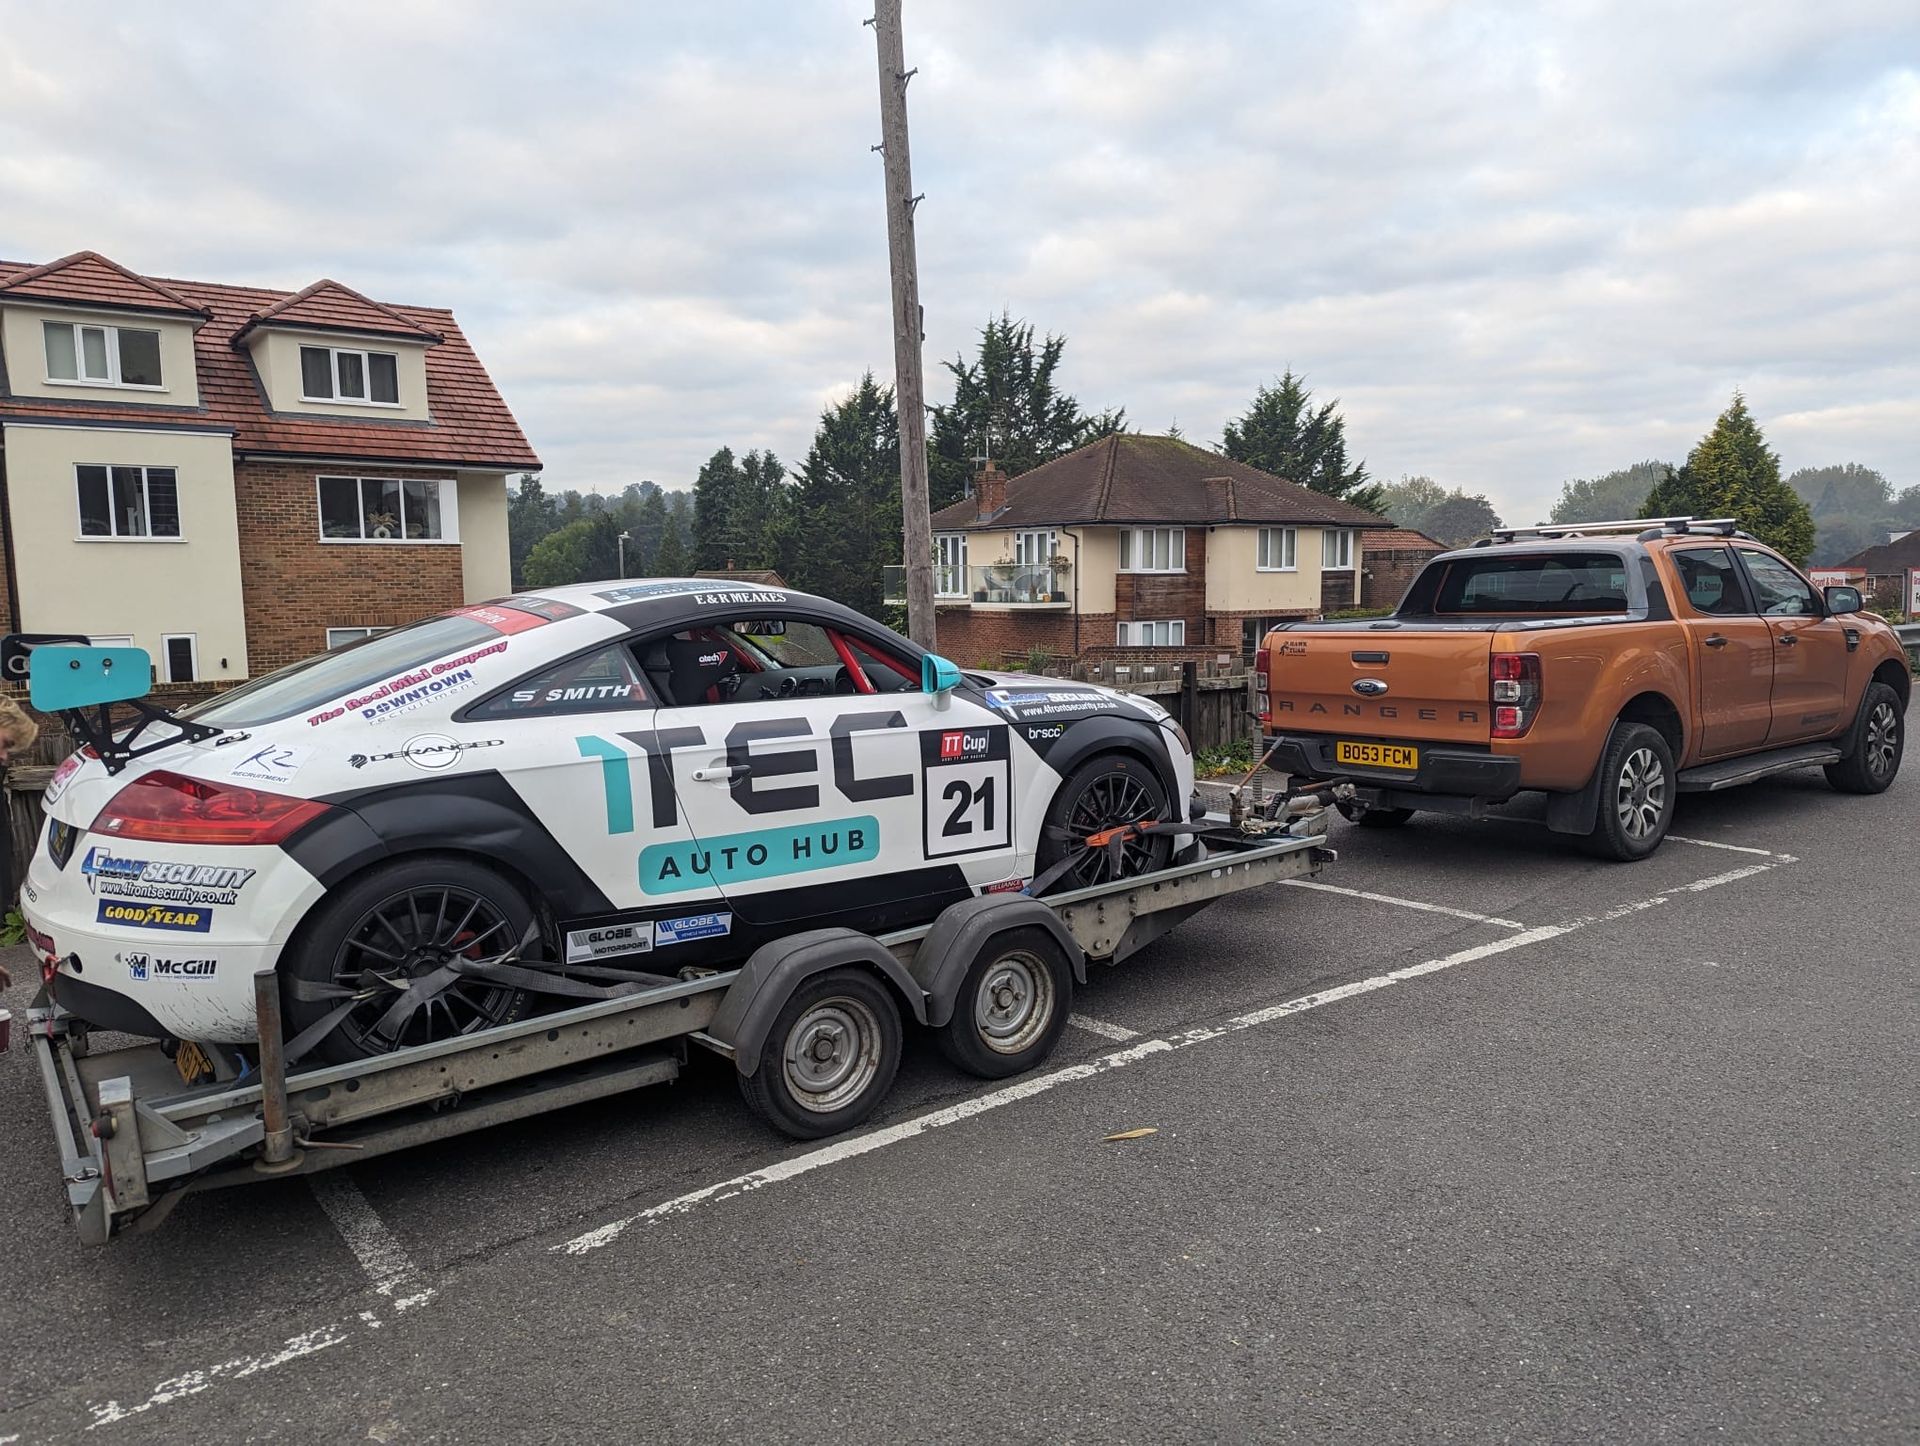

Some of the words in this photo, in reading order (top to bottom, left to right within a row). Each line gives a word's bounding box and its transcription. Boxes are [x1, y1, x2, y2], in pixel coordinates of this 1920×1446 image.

[694, 594, 706, 605] E
[706, 593, 719, 604] &
[719, 593, 730, 603] R
[730, 592, 787, 603] MEAKES
[307, 706, 345, 728] The
[344, 686, 391, 712] Real
[390, 668, 432, 693] Mini
[431, 640, 509, 676] Company
[511, 690, 537, 702] S
[545, 684, 632, 702] SMITH
[361, 668, 474, 719] DOWNTOWN
[368, 679, 479, 727] recruitment
[1279, 701, 1479, 723] RANGER
[1028, 727, 1061, 740] brscc
[944, 735, 961, 752] TT
[962, 734, 986, 752] Cup
[1383, 748, 1412, 765] FCM
[231, 771, 289, 783] RECRUITMENT
[942, 776, 994, 838] 21
[658, 844, 769, 881] AUTO
[792, 829, 866, 860] HUB
[142, 862, 256, 889] SECURITY
[99, 880, 238, 905] www.4frontsecurity.co.uk
[674, 916, 715, 930] GLOBE
[588, 927, 633, 943] GLOBE
[594, 941, 648, 954] MOTORSPORT
[153, 959, 217, 975] McGill
